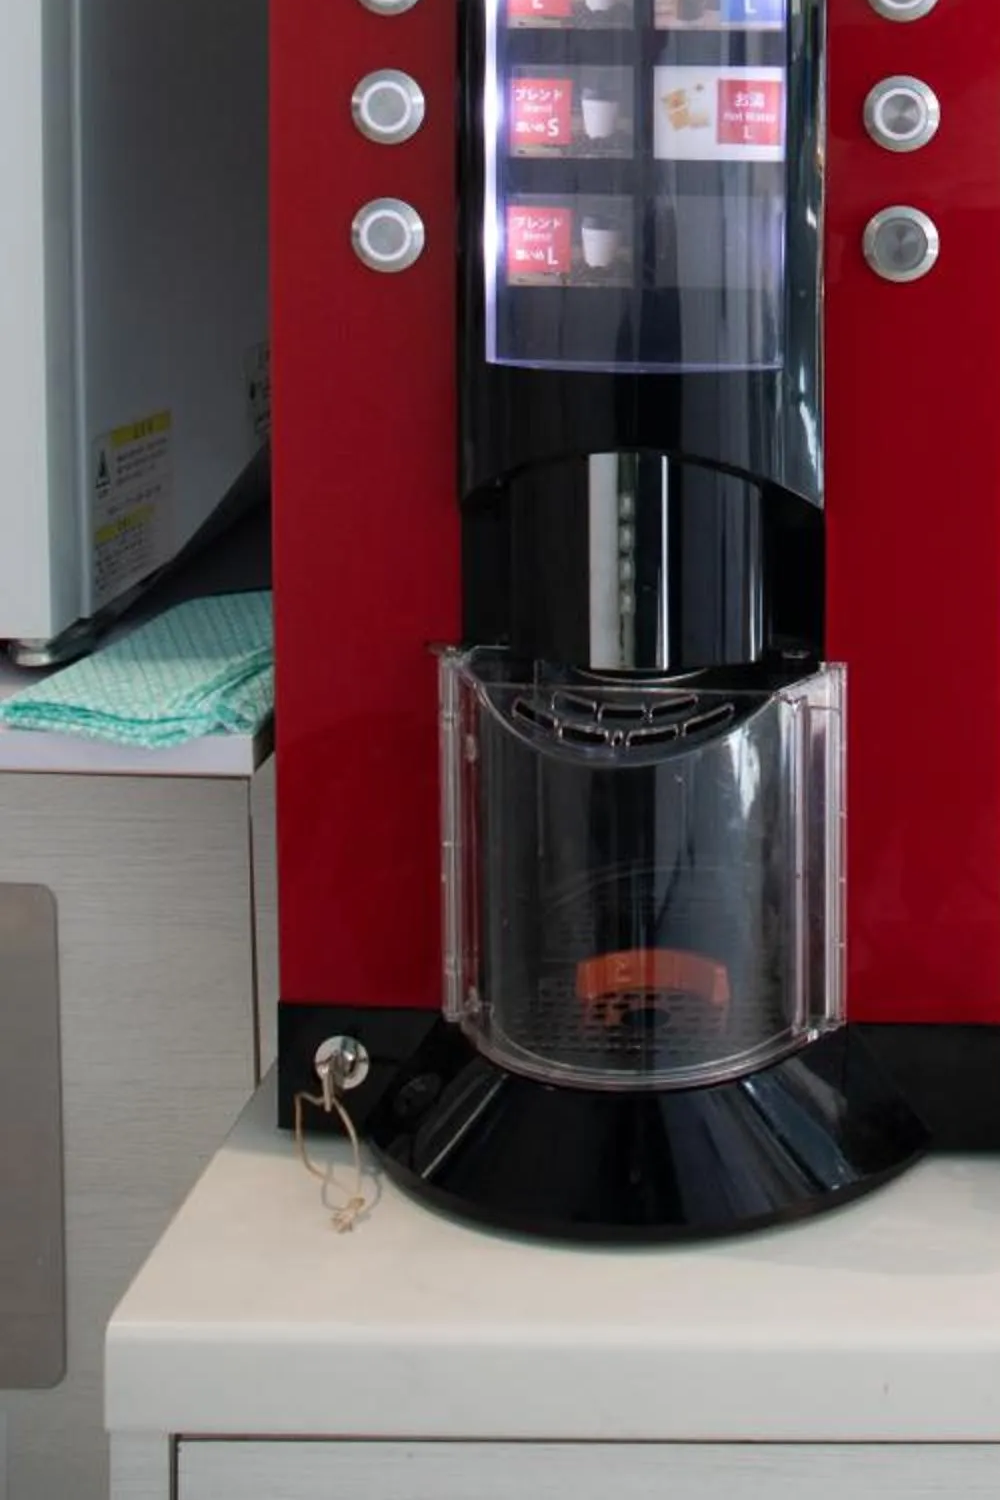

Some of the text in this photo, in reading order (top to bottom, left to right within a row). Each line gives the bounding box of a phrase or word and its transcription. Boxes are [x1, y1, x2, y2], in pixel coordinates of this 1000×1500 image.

[547, 117, 560, 138] S
[743, 125, 753, 140] L
[547, 246, 559, 266] L
